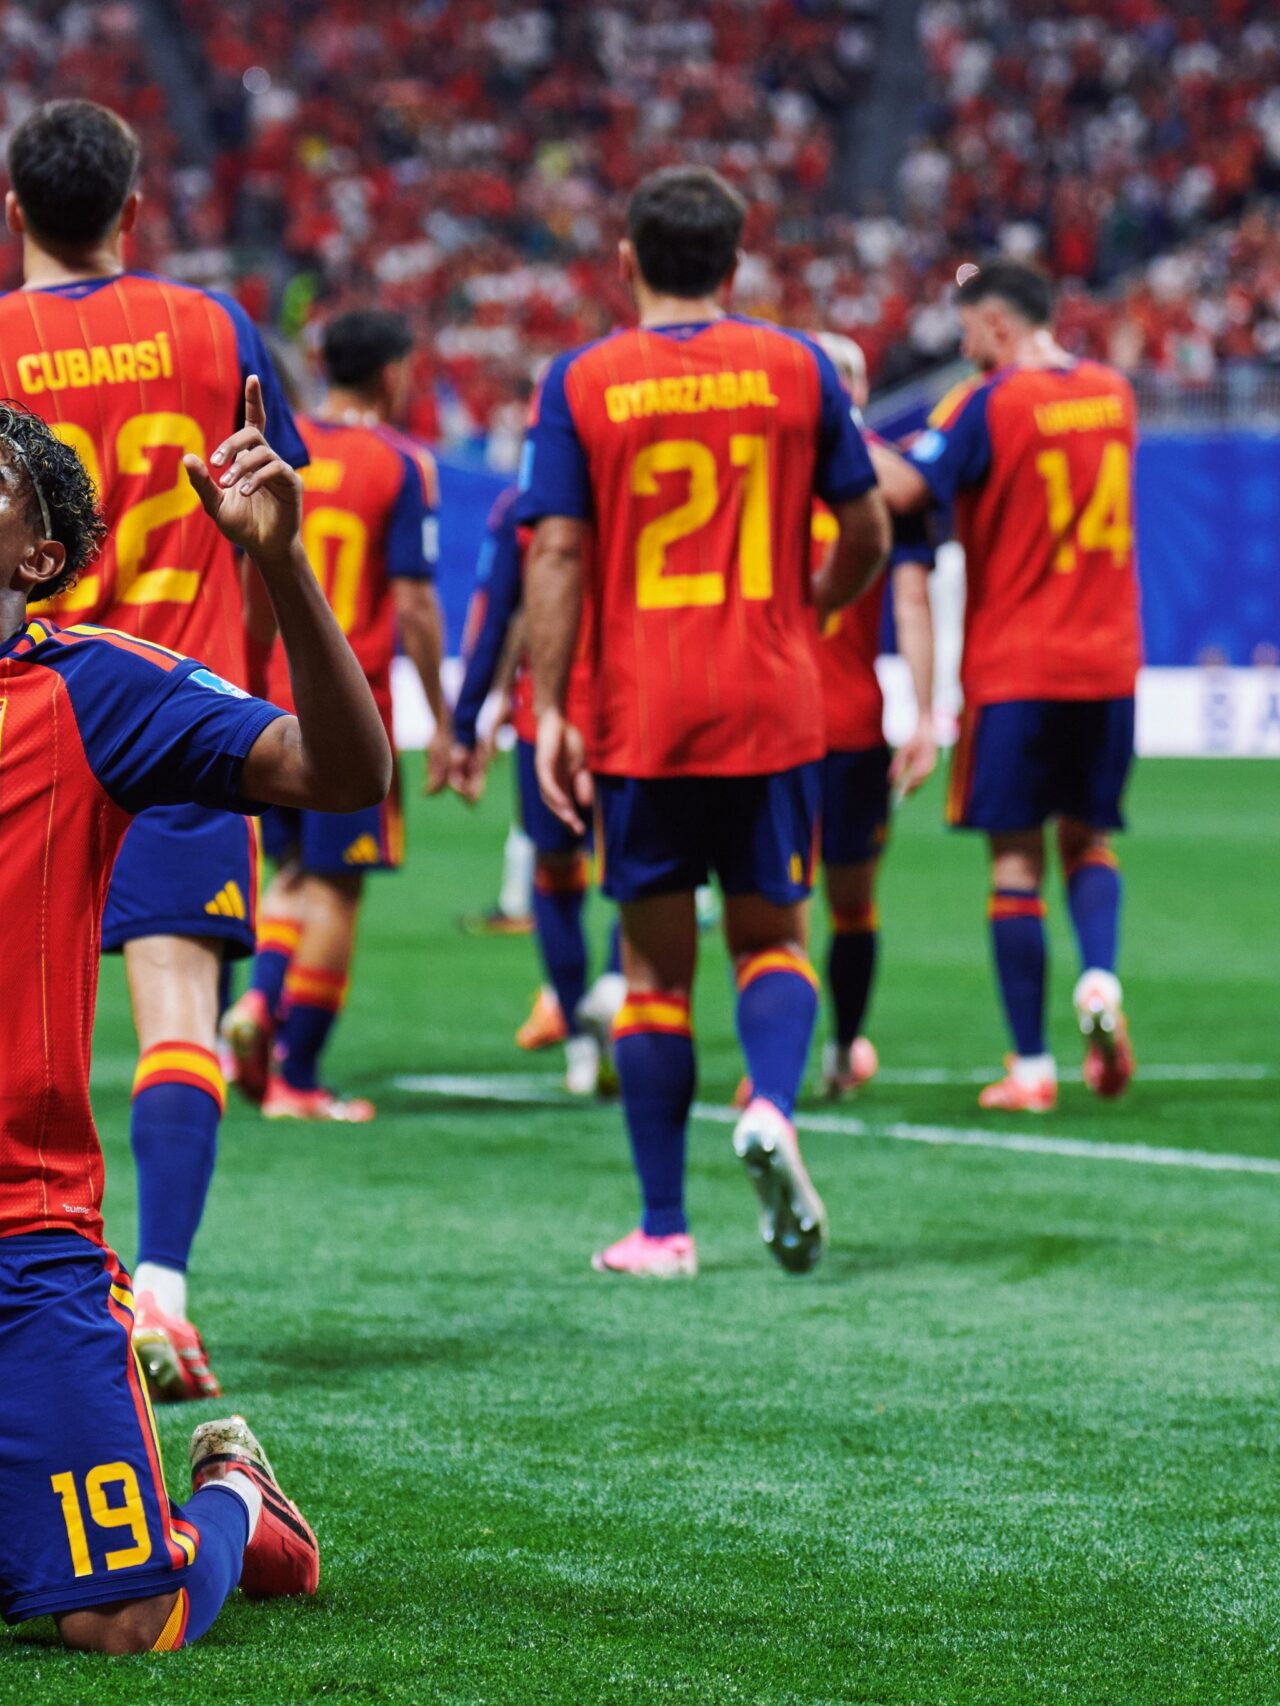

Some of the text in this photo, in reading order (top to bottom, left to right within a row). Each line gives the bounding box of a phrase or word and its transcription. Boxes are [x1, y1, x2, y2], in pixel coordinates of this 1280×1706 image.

[17, 331, 173, 395] CUBARSÍ
[605, 369, 780, 423] OYARZABAL
[631, 434, 773, 611] 21
[1036, 440, 1134, 574] 14
[50, 1461, 152, 1578] 19
